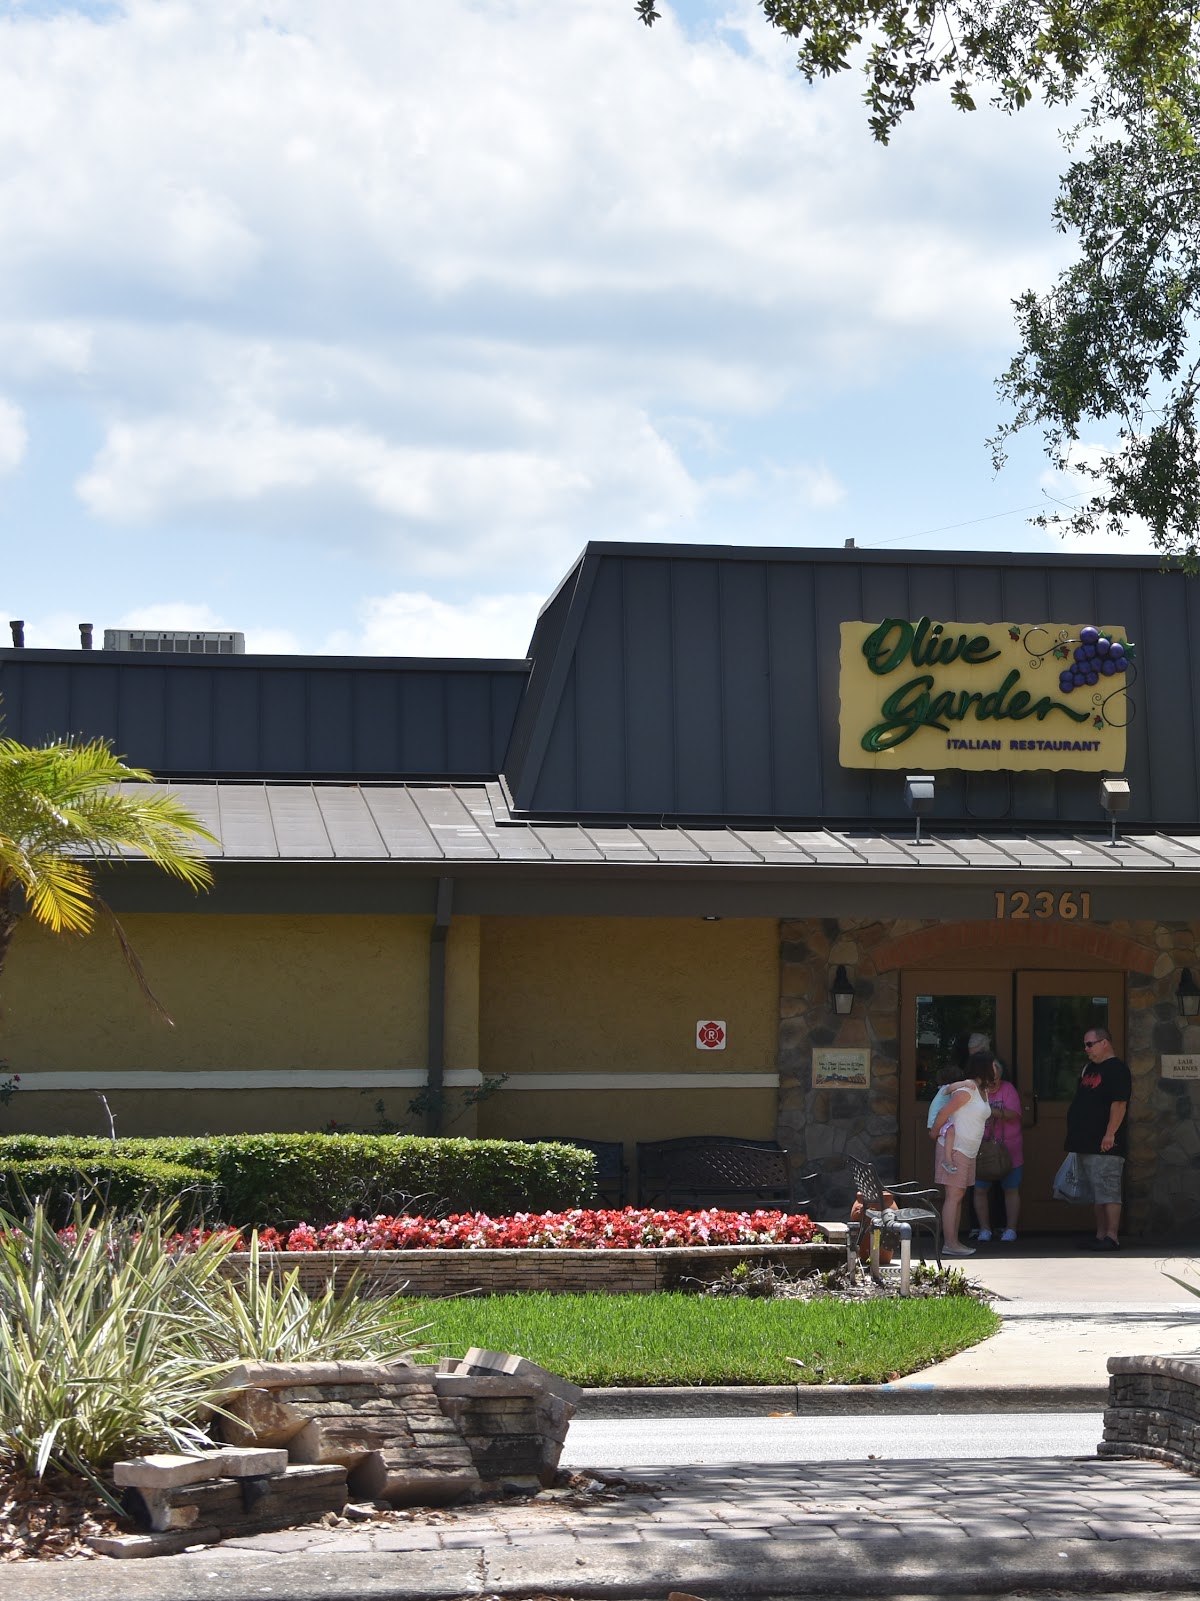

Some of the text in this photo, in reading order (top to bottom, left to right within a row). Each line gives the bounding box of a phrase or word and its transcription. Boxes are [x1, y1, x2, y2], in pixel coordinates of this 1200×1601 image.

[862, 616, 1002, 675] Olive
[861, 669, 1091, 752] Garden
[947, 739, 1101, 751] ITALIAN RESTAURANT
[995, 891, 1090, 919] 12361
[708, 1031, 715, 1039] R
